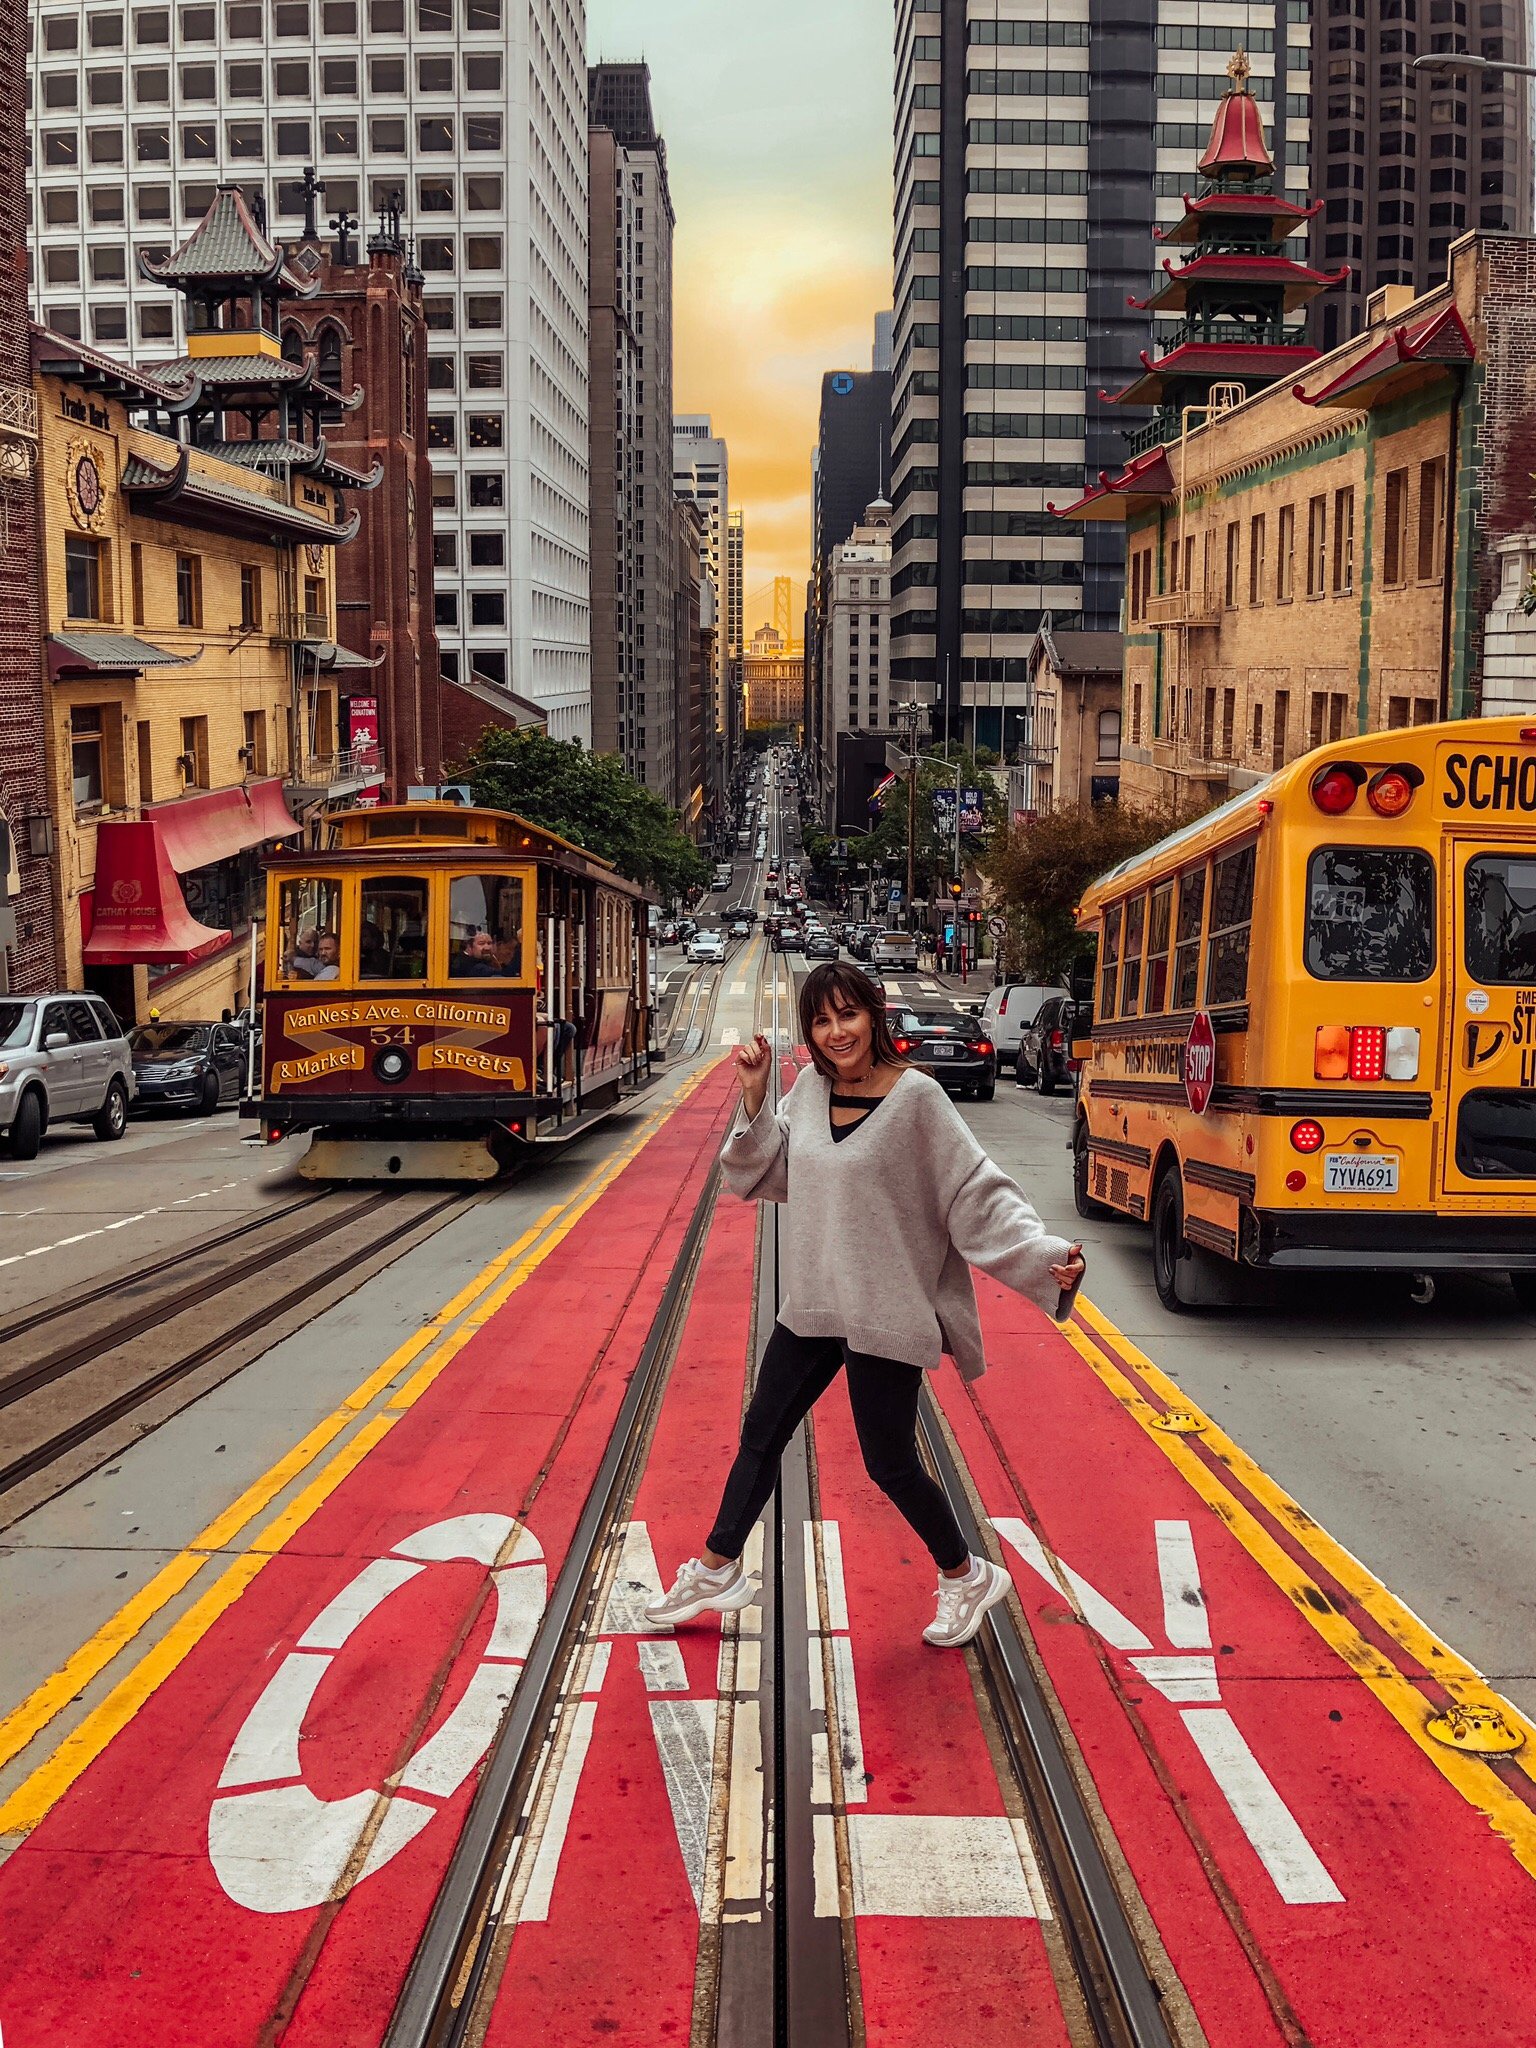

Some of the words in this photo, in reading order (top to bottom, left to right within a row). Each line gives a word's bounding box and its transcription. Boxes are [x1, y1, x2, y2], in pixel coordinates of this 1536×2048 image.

[60, 391, 86, 422] Trade
[349, 700, 370, 708] WELCOME
[371, 700, 377, 708] TO
[351, 708, 376, 716] CHINATOWN
[1443, 753, 1536, 811] SCHO
[96, 907, 128, 917] CATHAY
[129, 907, 157, 916] HOUSE
[414, 1003, 507, 1026] California
[1513, 1005, 1536, 1045] ST
[370, 1025, 416, 1046] 54
[281, 1063, 293, 1079] &
[296, 1049, 357, 1078] Market
[433, 1048, 513, 1074] Streets
[1125, 1045, 1146, 1073] FIRST
[1147, 1043, 1181, 1075] STUDEN
[1188, 1045, 1211, 1081] STOP
[1340, 1156, 1385, 1168] California
[1329, 1168, 1393, 1187] 7YVA691
[208, 1512, 1346, 1924] ONLY
